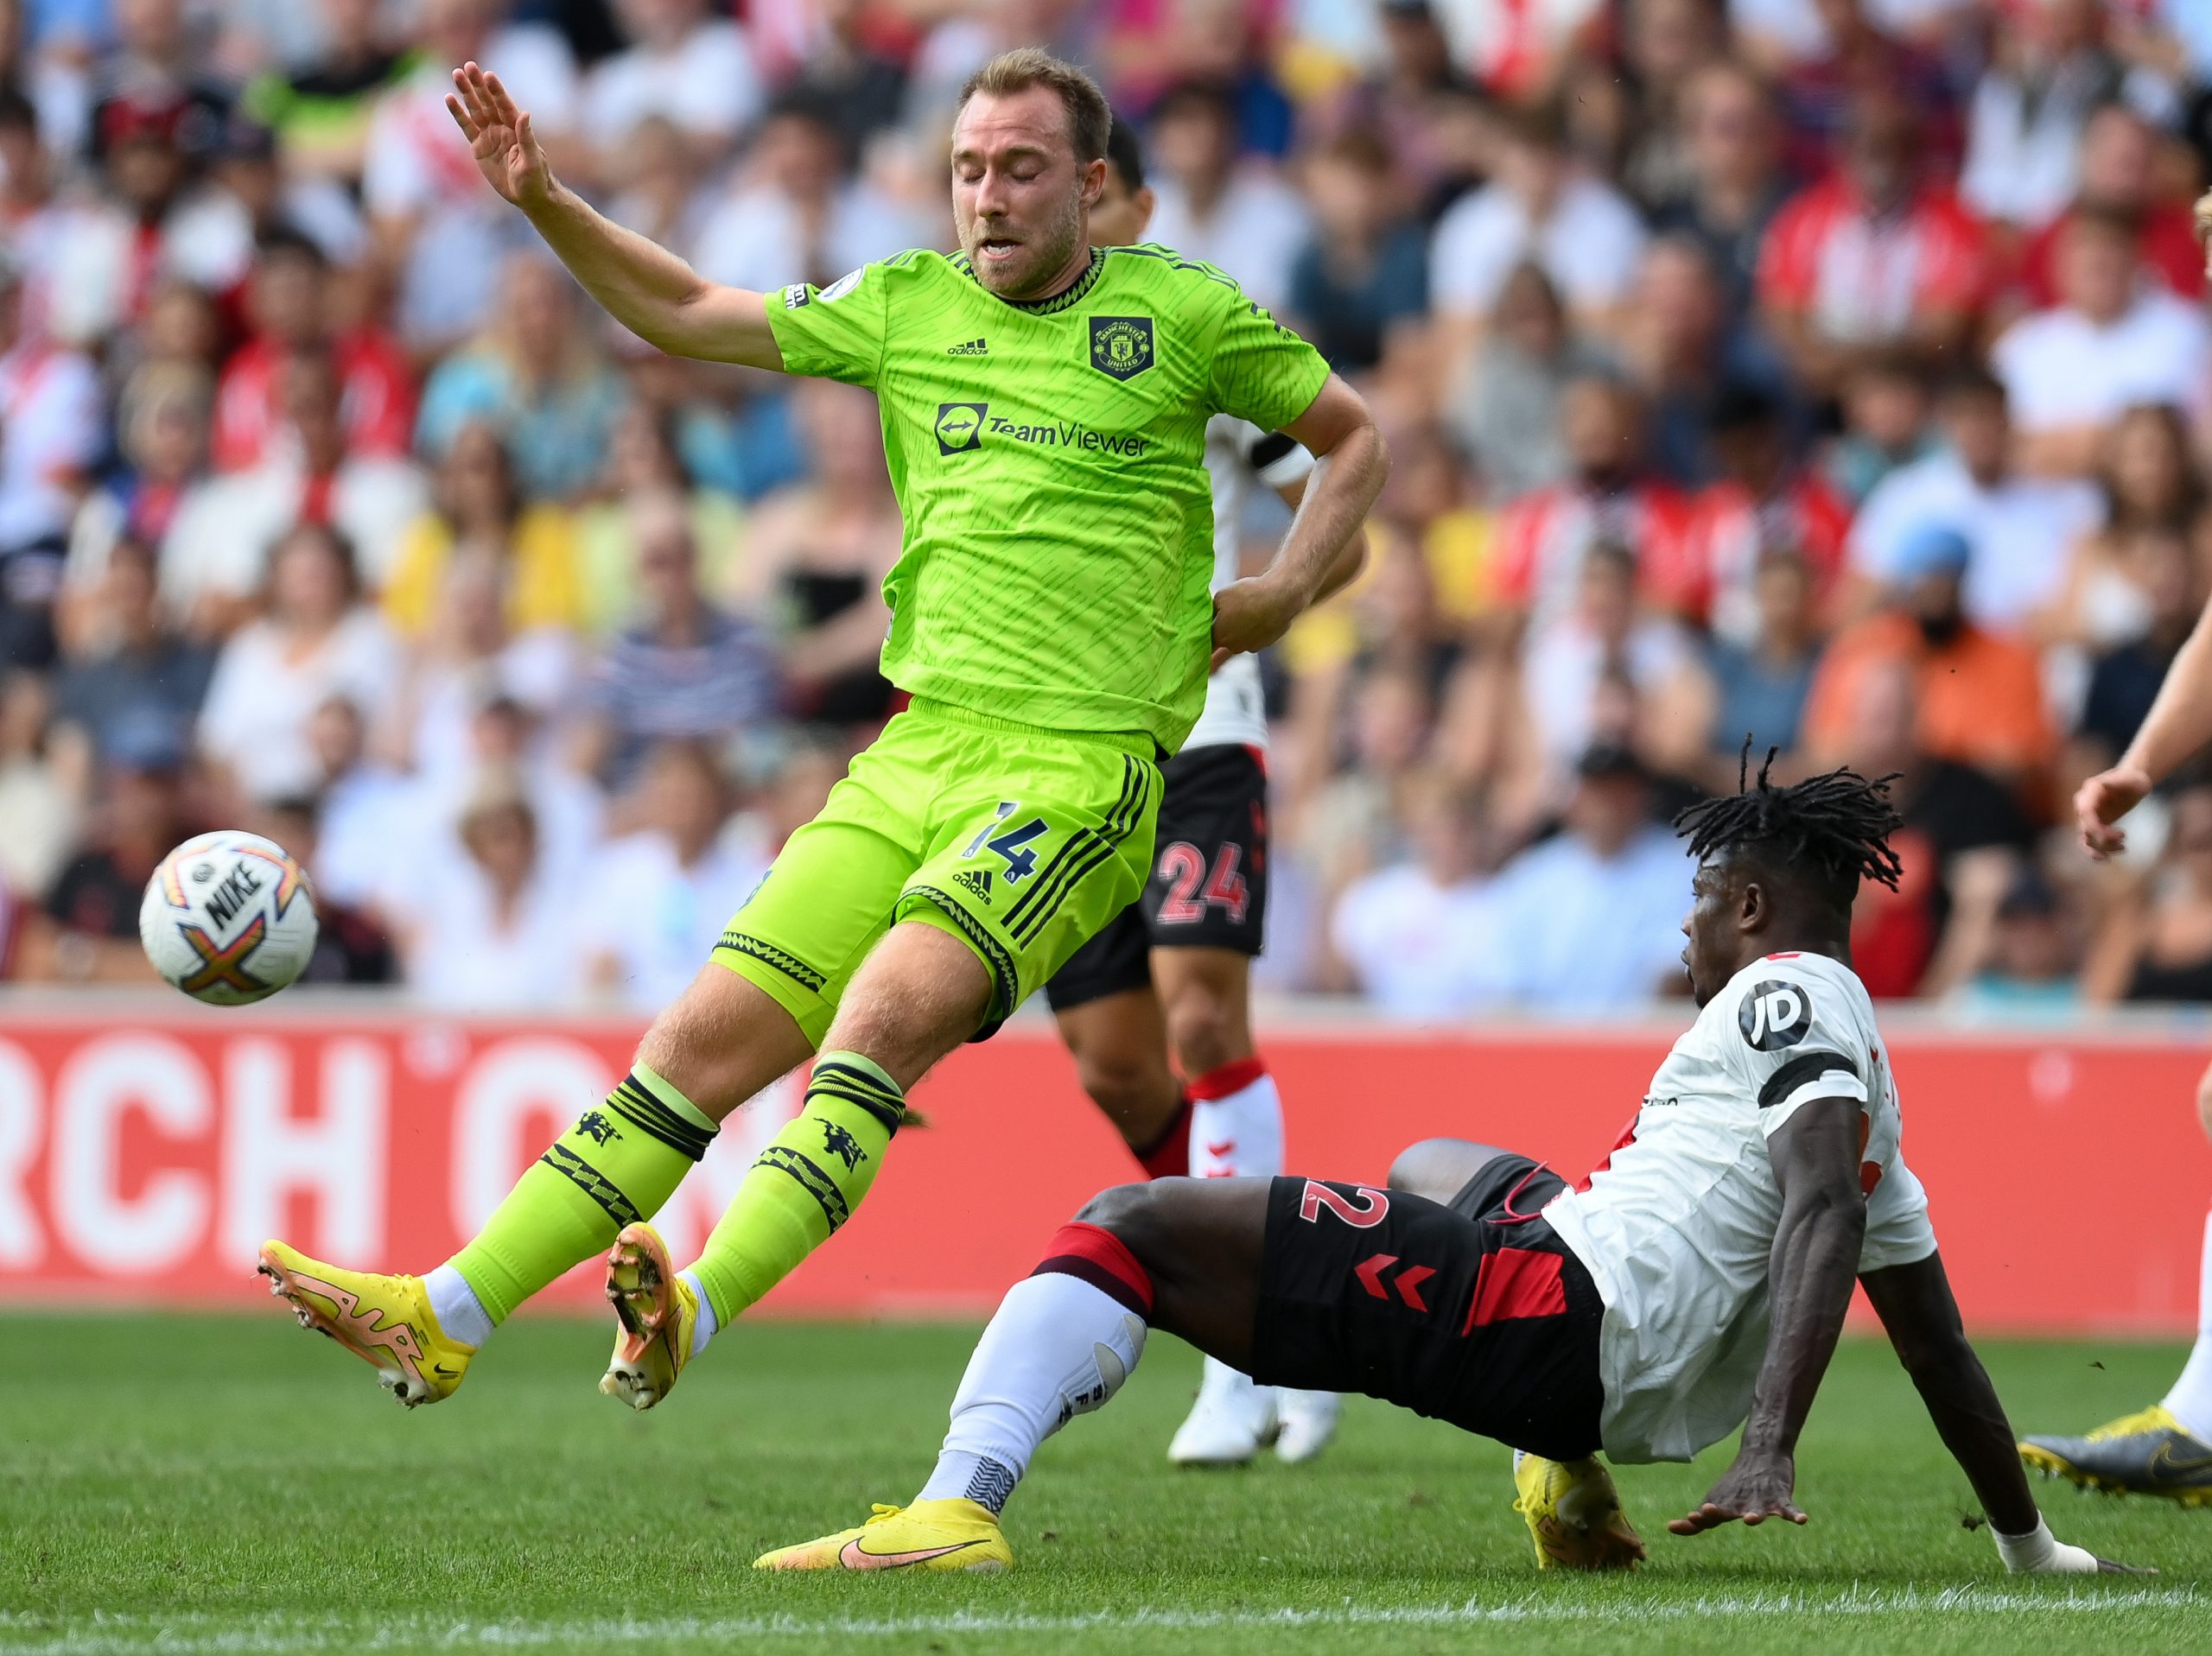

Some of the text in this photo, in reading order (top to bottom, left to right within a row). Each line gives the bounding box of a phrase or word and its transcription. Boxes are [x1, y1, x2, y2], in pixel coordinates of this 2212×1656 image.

[947, 346, 988, 355] adidas
[1100, 325, 1143, 341] MANCHESTER
[1107, 358, 1138, 369] UNITED
[989, 417, 1150, 456] TeamViewer
[961, 801, 1051, 886] 14
[205, 860, 262, 932] NIKE
[952, 873, 992, 905] adidas
[1156, 841, 1250, 924] 24
[1750, 989, 1802, 1045] JD
